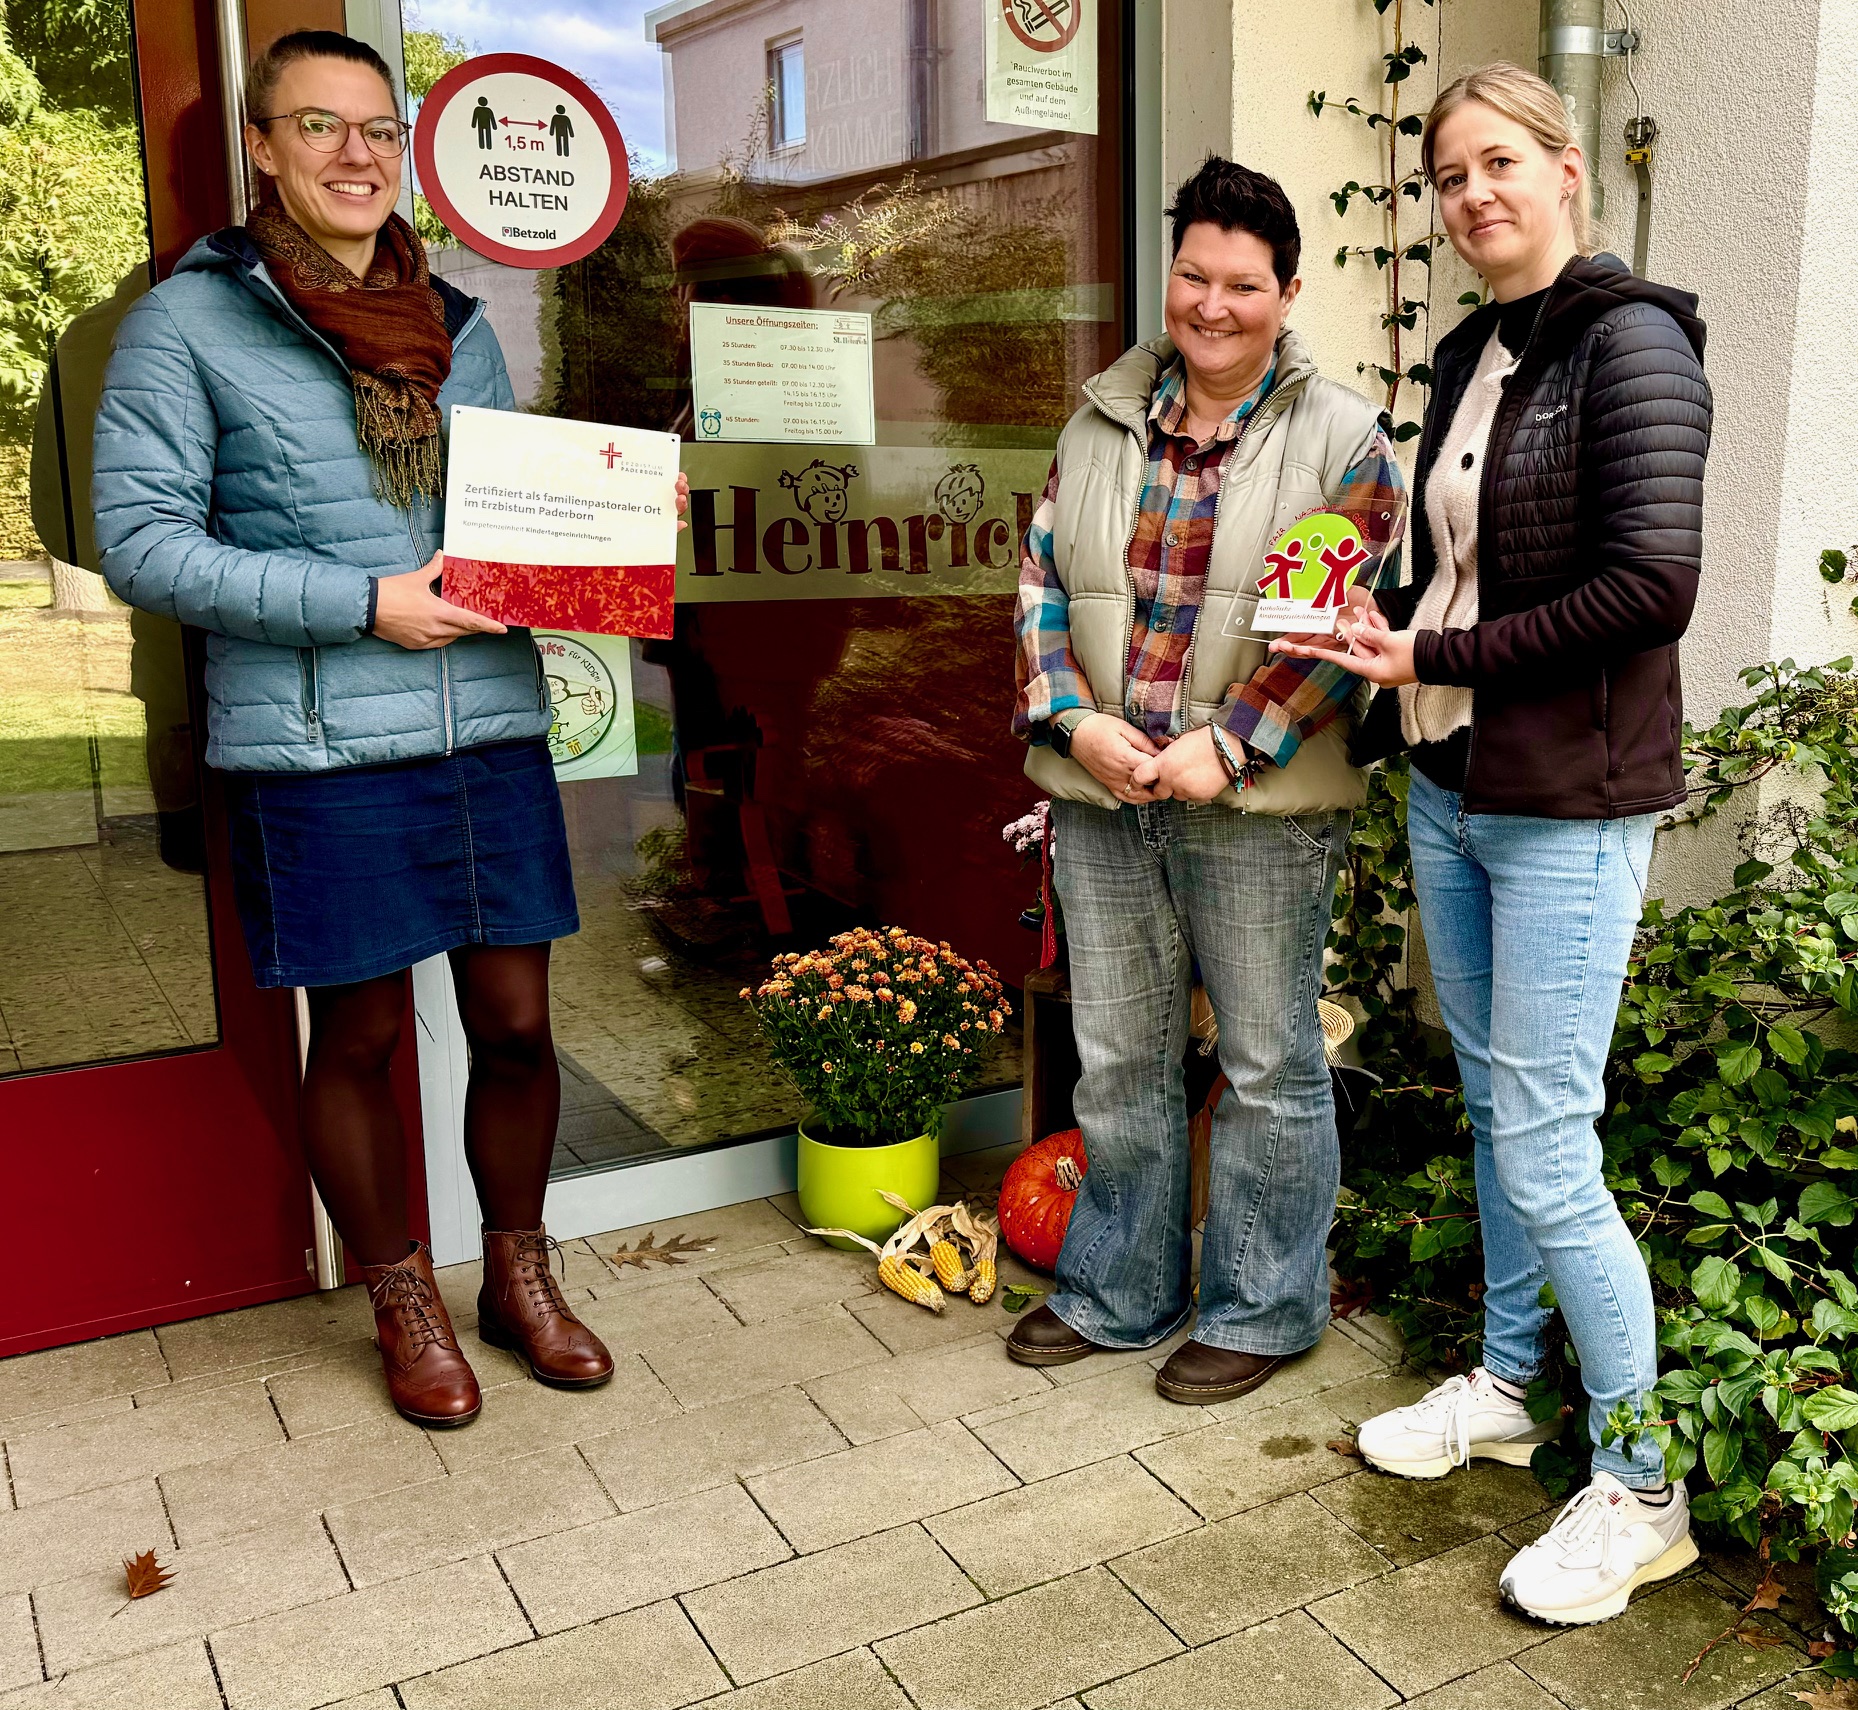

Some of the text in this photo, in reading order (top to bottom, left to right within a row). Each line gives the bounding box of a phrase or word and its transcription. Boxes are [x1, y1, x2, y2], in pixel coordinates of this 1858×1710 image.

[1062, 70, 1072, 78] im
[1006, 77, 1078, 93] gesamten Gebäude
[1019, 93, 1066, 105] und auf dem
[504, 134, 545, 151] 1,5 m
[479, 164, 575, 187] ABSTAND
[488, 189, 568, 211] HALTEN
[513, 227, 557, 240] Betzold
[725, 316, 819, 330] Unsere Öffnungszeiten:
[783, 400, 804, 408] Freitag
[621, 466, 663, 476] PADERBORN
[465, 484, 662, 515] Zertifiziert als familienpastoraler Ort
[464, 498, 594, 521] im Erzbistum Paderborn
[462, 519, 612, 542] Kompetenzeinheit Kindertageseinrichtungen
